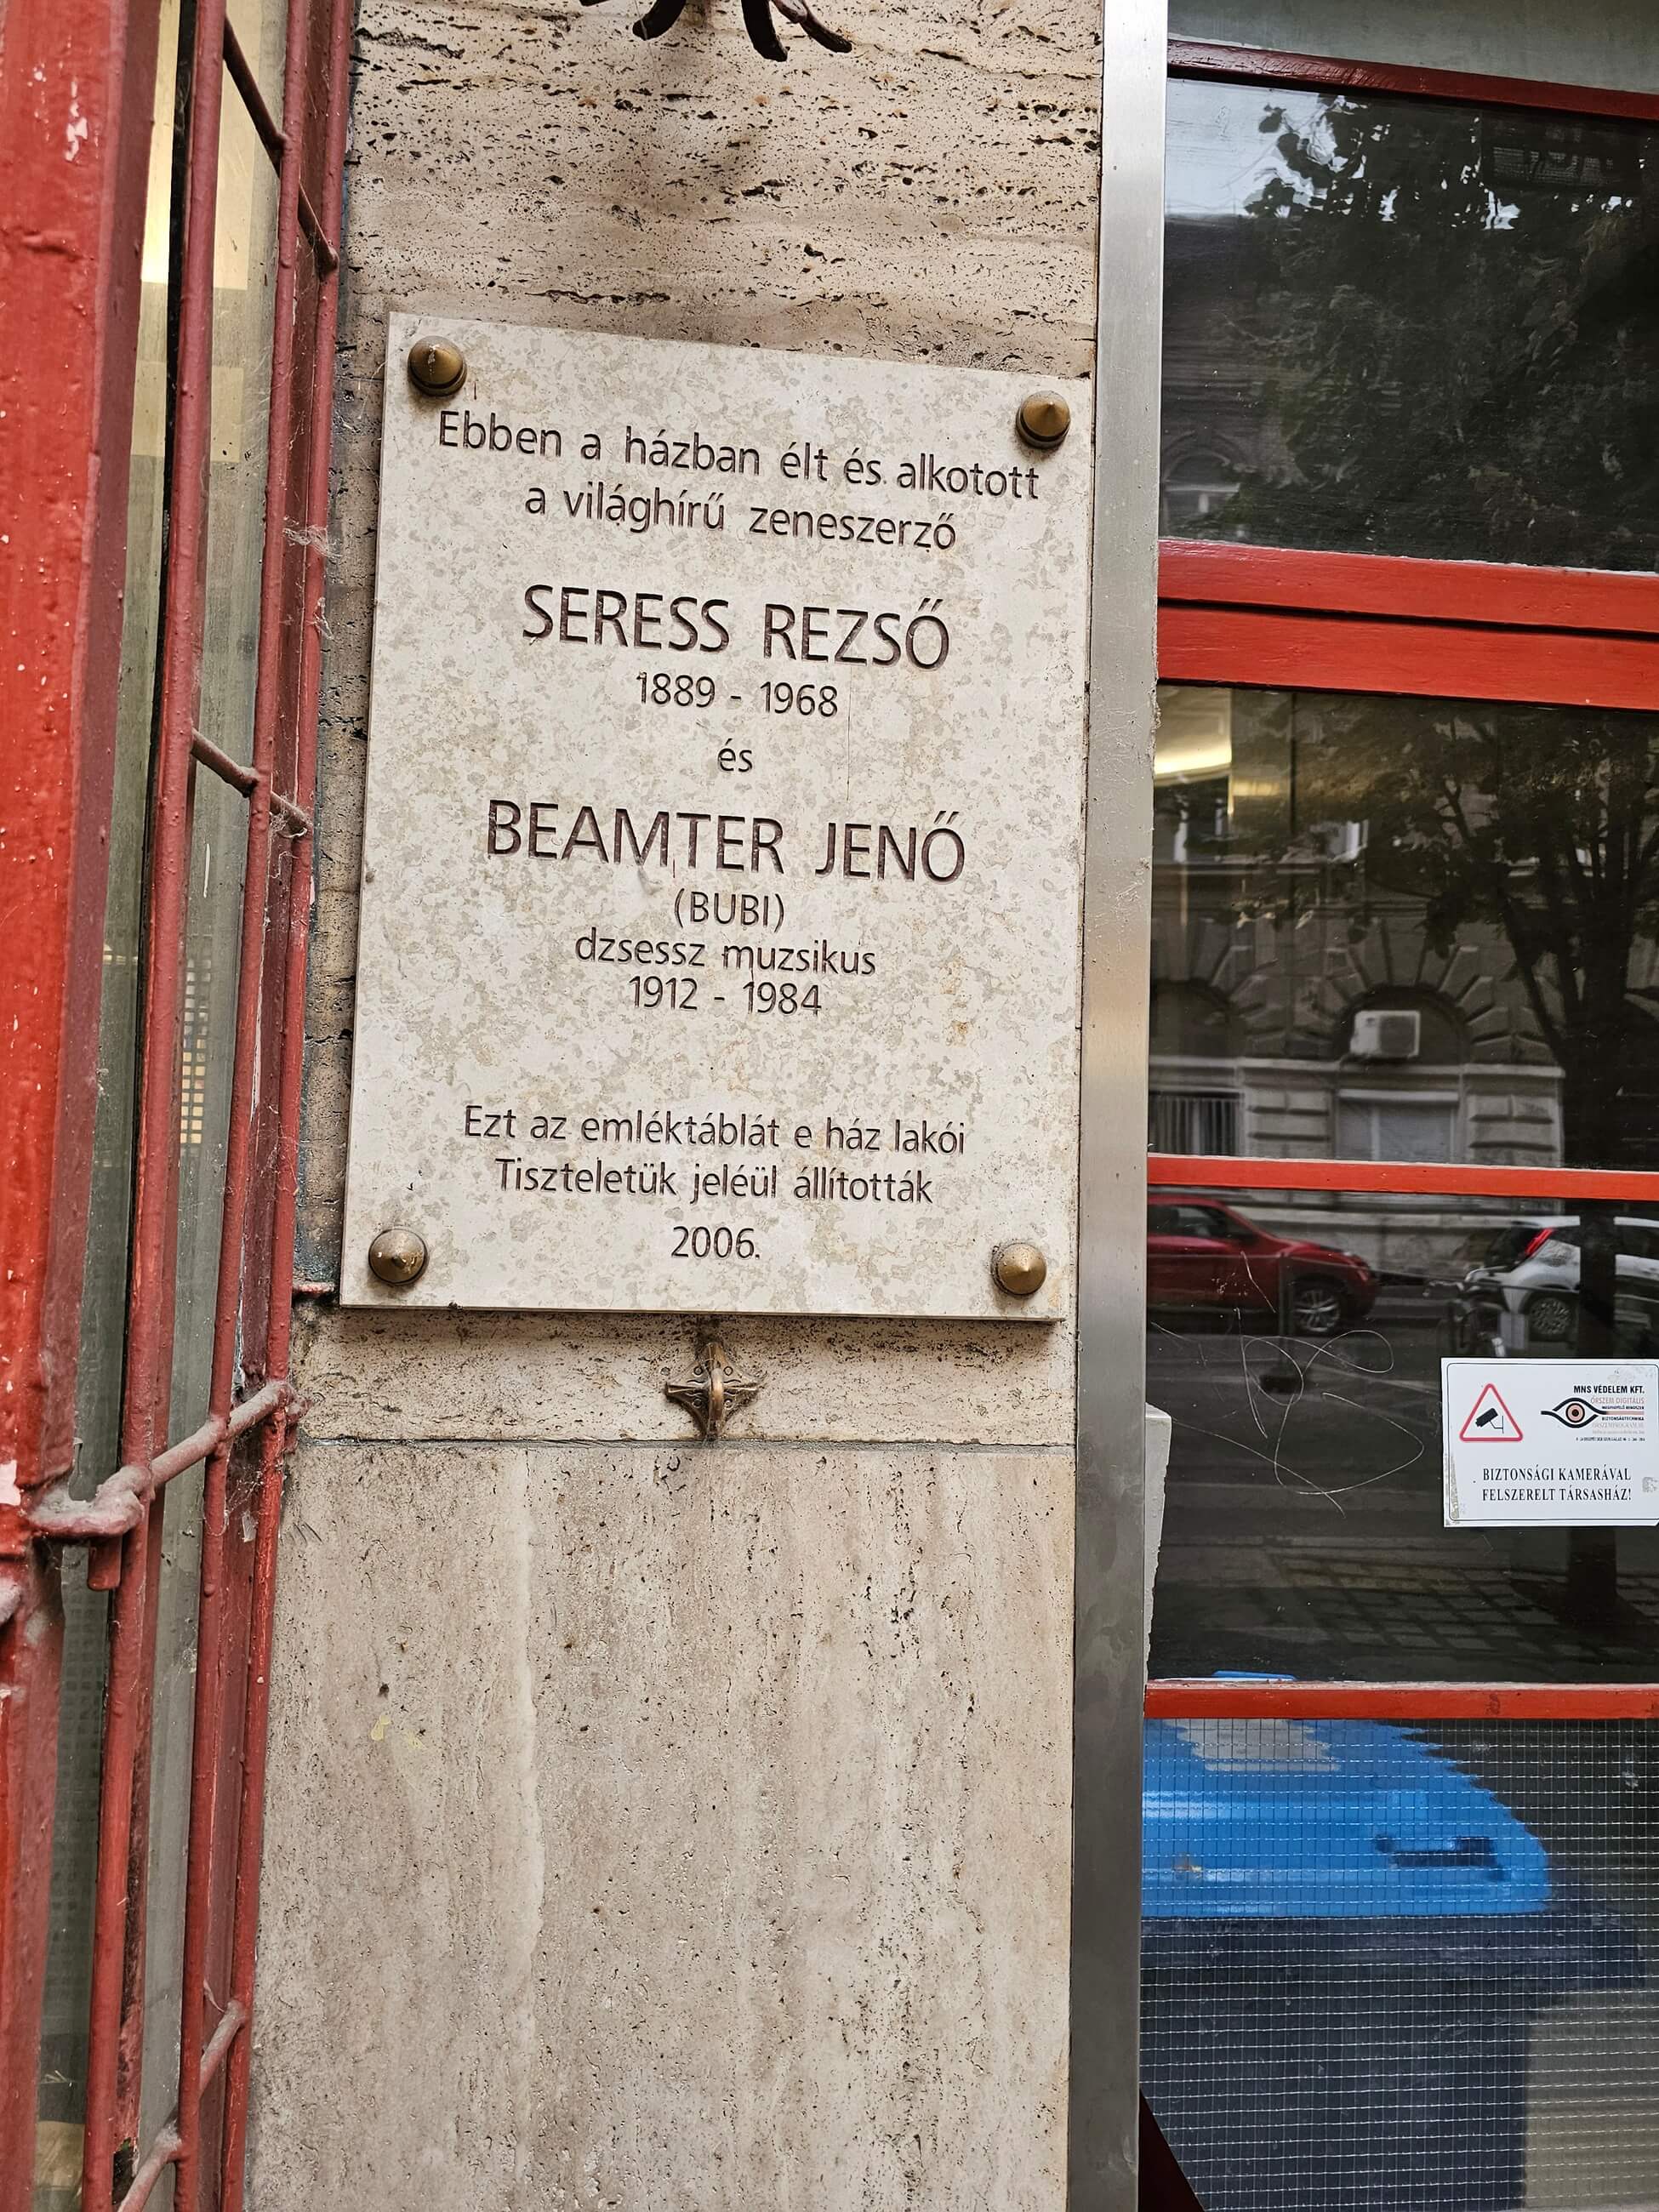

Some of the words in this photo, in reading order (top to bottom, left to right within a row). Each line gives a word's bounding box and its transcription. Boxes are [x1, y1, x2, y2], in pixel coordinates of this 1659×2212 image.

[439, 410, 562, 458] Ebben
[581, 433, 601, 459] a
[626, 425, 760, 476] házban
[781, 442, 828, 481] élt
[844, 448, 881, 485] és
[898, 453, 1040, 500] alkotott
[526, 488, 545, 514] a
[564, 482, 723, 533] világhírű
[750, 507, 955, 550] zeneszerző
[522, 584, 731, 653] SERESS
[764, 598, 949, 670] REZSŐ
[636, 673, 715, 708] 1889
[761, 681, 838, 716] 1968
[717, 739, 754, 773] és
[487, 800, 784, 874] BEAMTER
[816, 811, 966, 884] JENŐ
[674, 887, 785, 932] (BUBI)
[574, 927, 705, 968] dzsessz
[721, 939, 875, 977] muzsikus
[630, 976, 698, 1011] 1912
[744, 982, 822, 1015] 1984
[465, 1105, 516, 1138] Ezt
[530, 1116, 567, 1139] az
[581, 1109, 779, 1147] emléktáblát
[795, 1126, 812, 1149] e
[826, 1117, 881, 1151] ház
[895, 1120, 964, 1154] lakói
[495, 1158, 676, 1195] Tiszteletük
[690, 1163, 777, 1205] jeléül
[793, 1166, 932, 1203] állították
[671, 1226, 760, 1259] 2006.
[1593, 1385, 1627, 1394] VÉDELEM
[1483, 1464, 1554, 1480] BIZTONSÁGI
[1559, 1464, 1631, 1480] KAMERÁVAL
[1483, 1489, 1555, 1501] FELSZERELT
[1559, 1485, 1632, 1501] TÁRSASHÁZ!
